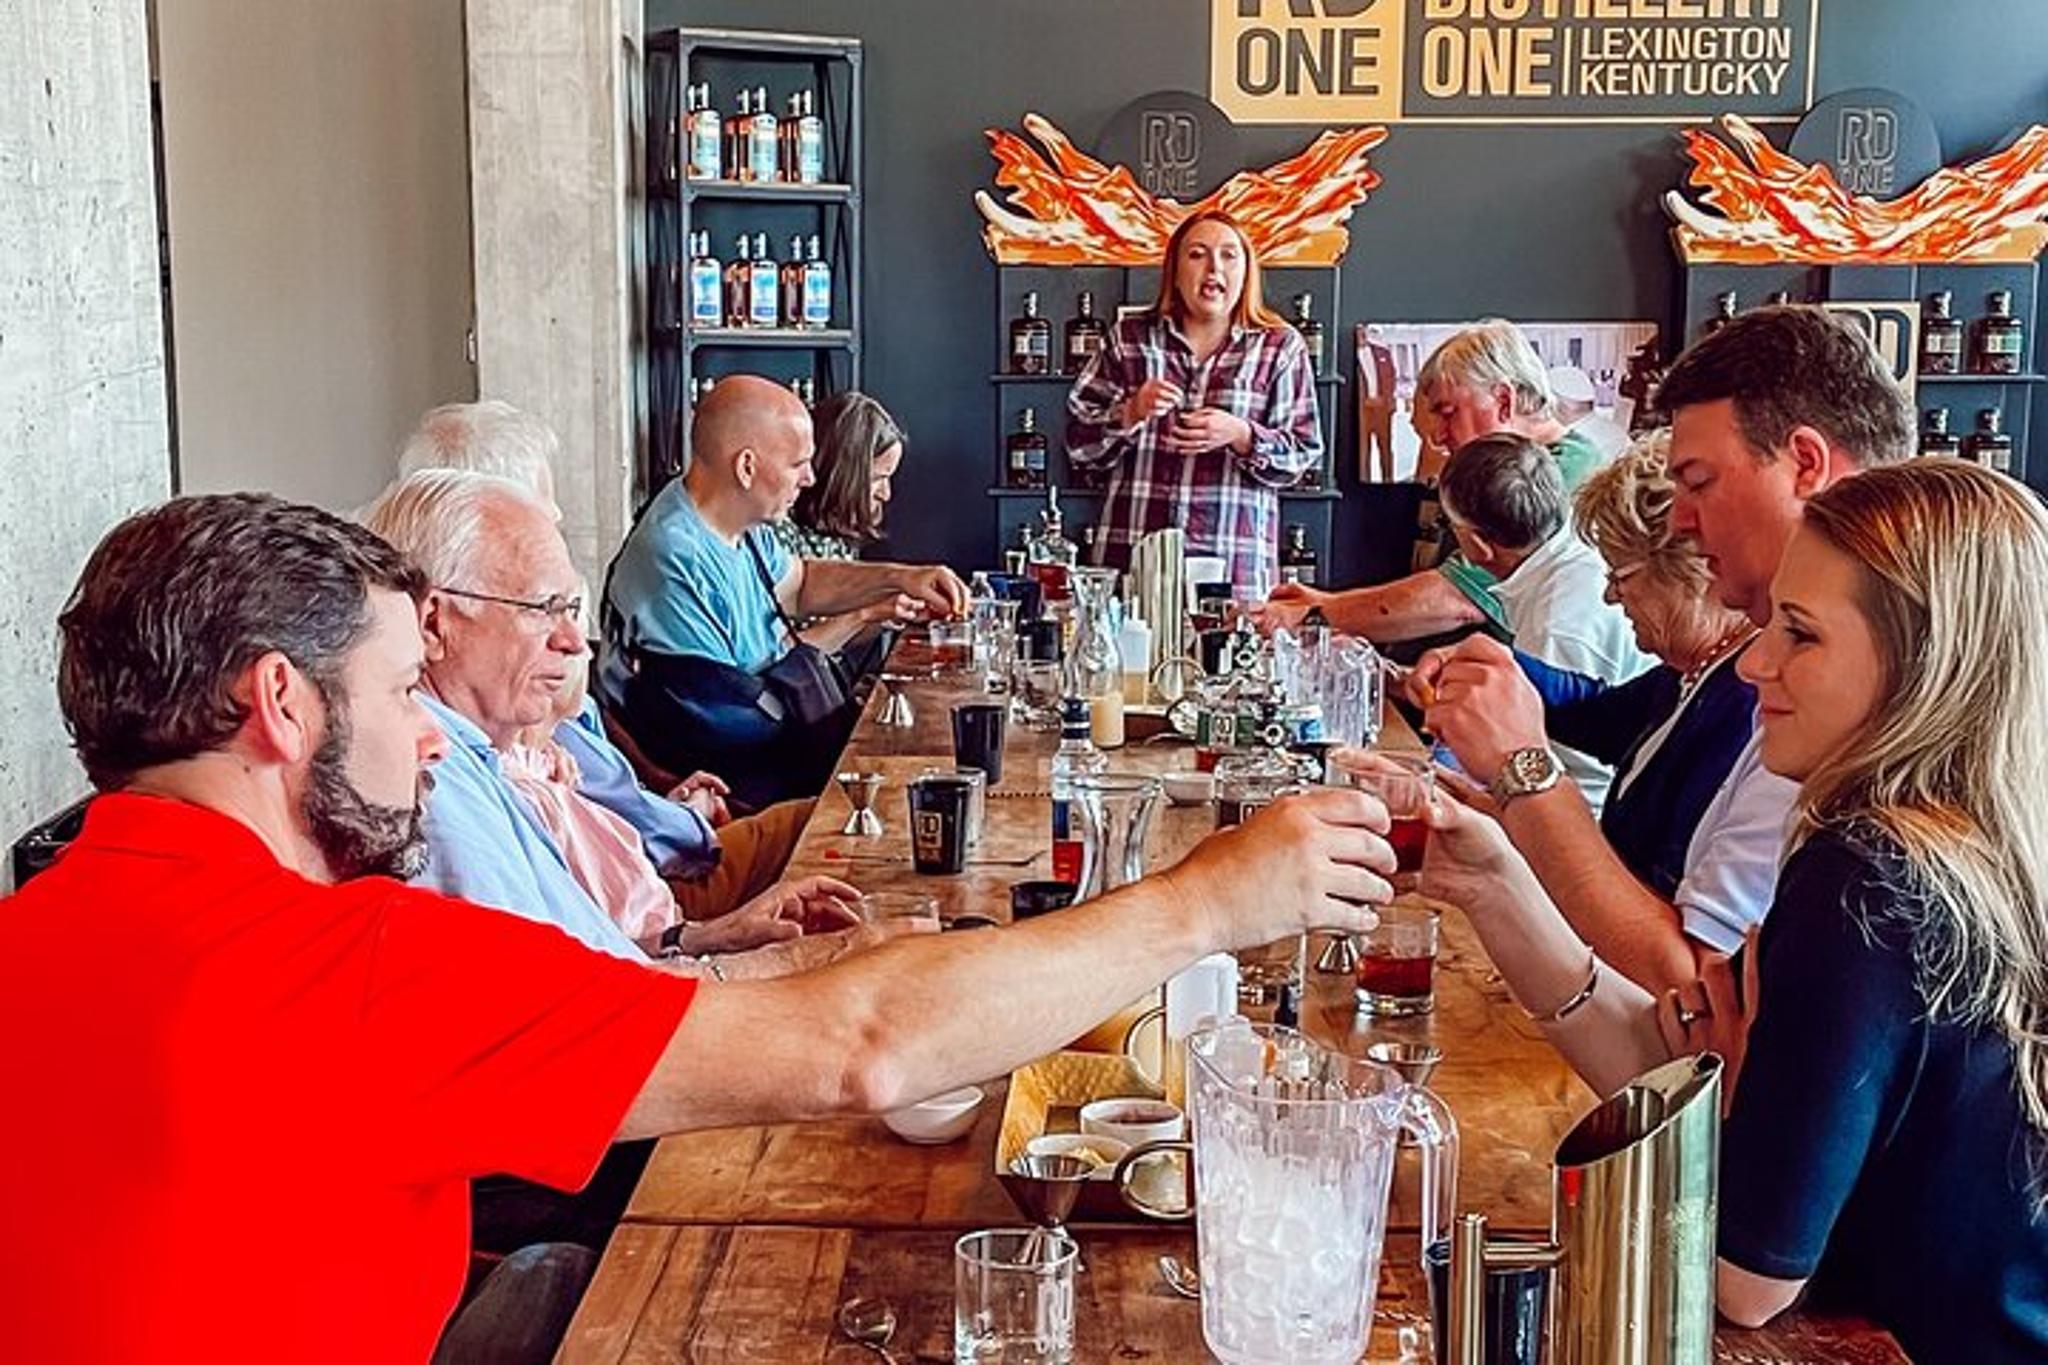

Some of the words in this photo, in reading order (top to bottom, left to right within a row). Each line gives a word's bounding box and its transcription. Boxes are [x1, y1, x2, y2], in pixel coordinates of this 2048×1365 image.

[1237, 28, 1381, 96] ONE
[1423, 25, 1554, 97] ONE
[1581, 26, 1791, 61] LEXINGTON
[1580, 62, 1790, 95] KENTUCKY
[1141, 110, 1199, 168] RD
[1837, 108, 1898, 166] RD
